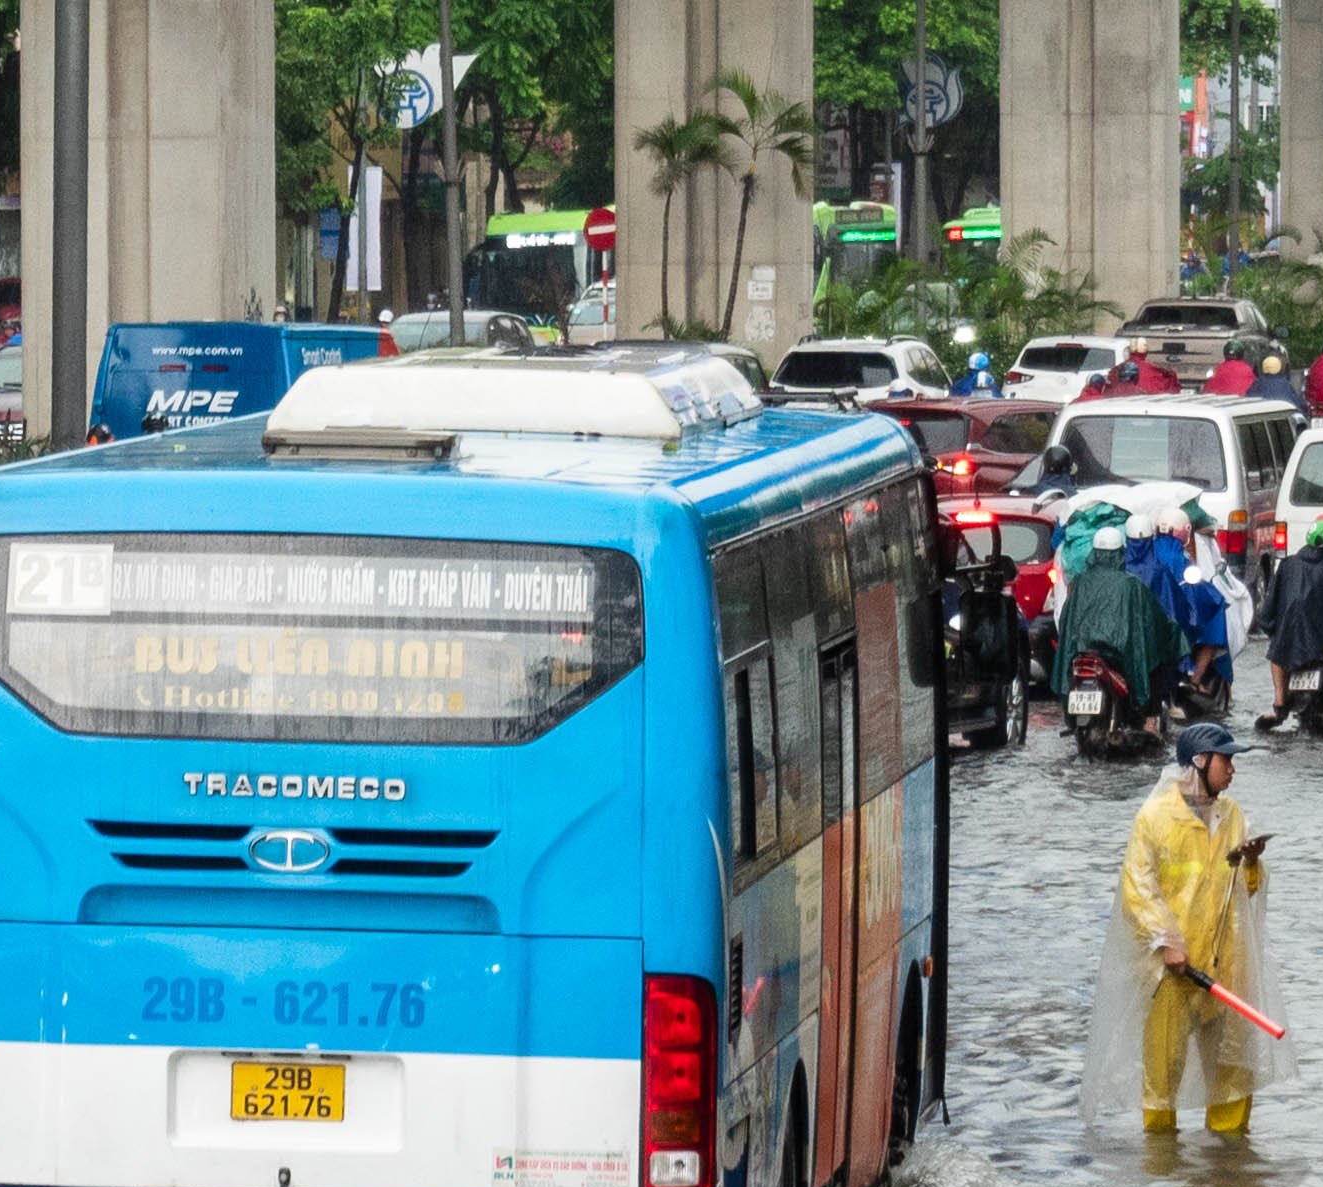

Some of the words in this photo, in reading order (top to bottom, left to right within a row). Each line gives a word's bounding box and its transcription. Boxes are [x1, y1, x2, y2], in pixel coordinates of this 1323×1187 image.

[152, 346, 244, 357] www.mpe.com.vn
[147, 389, 239, 414] MPE
[114, 563, 133, 600] BX
[135, 560, 158, 601] MỸ
[161, 560, 197, 602] ĐÌNH
[210, 561, 242, 602] GIÁP
[245, 560, 275, 603] BÁT
[287, 560, 328, 603] NƯỚC
[331, 560, 375, 606] NGẦM
[388, 567, 417, 608] KĐT
[419, 563, 459, 609] PHÁP
[461, 564, 492, 610] VÂN
[504, 566, 553, 612] DUYÊN
[556, 566, 588, 613] THÁI
[134, 633, 220, 675] BUS
[347, 638, 465, 681] NINH
[164, 684, 295, 711] Hotline
[183, 772, 406, 801] TRACOMECO
[142, 975, 225, 1023] 29B
[274, 980, 426, 1028] 621.76
[264, 1067, 313, 1091] 29B
[244, 1094, 332, 1118] 621.76
